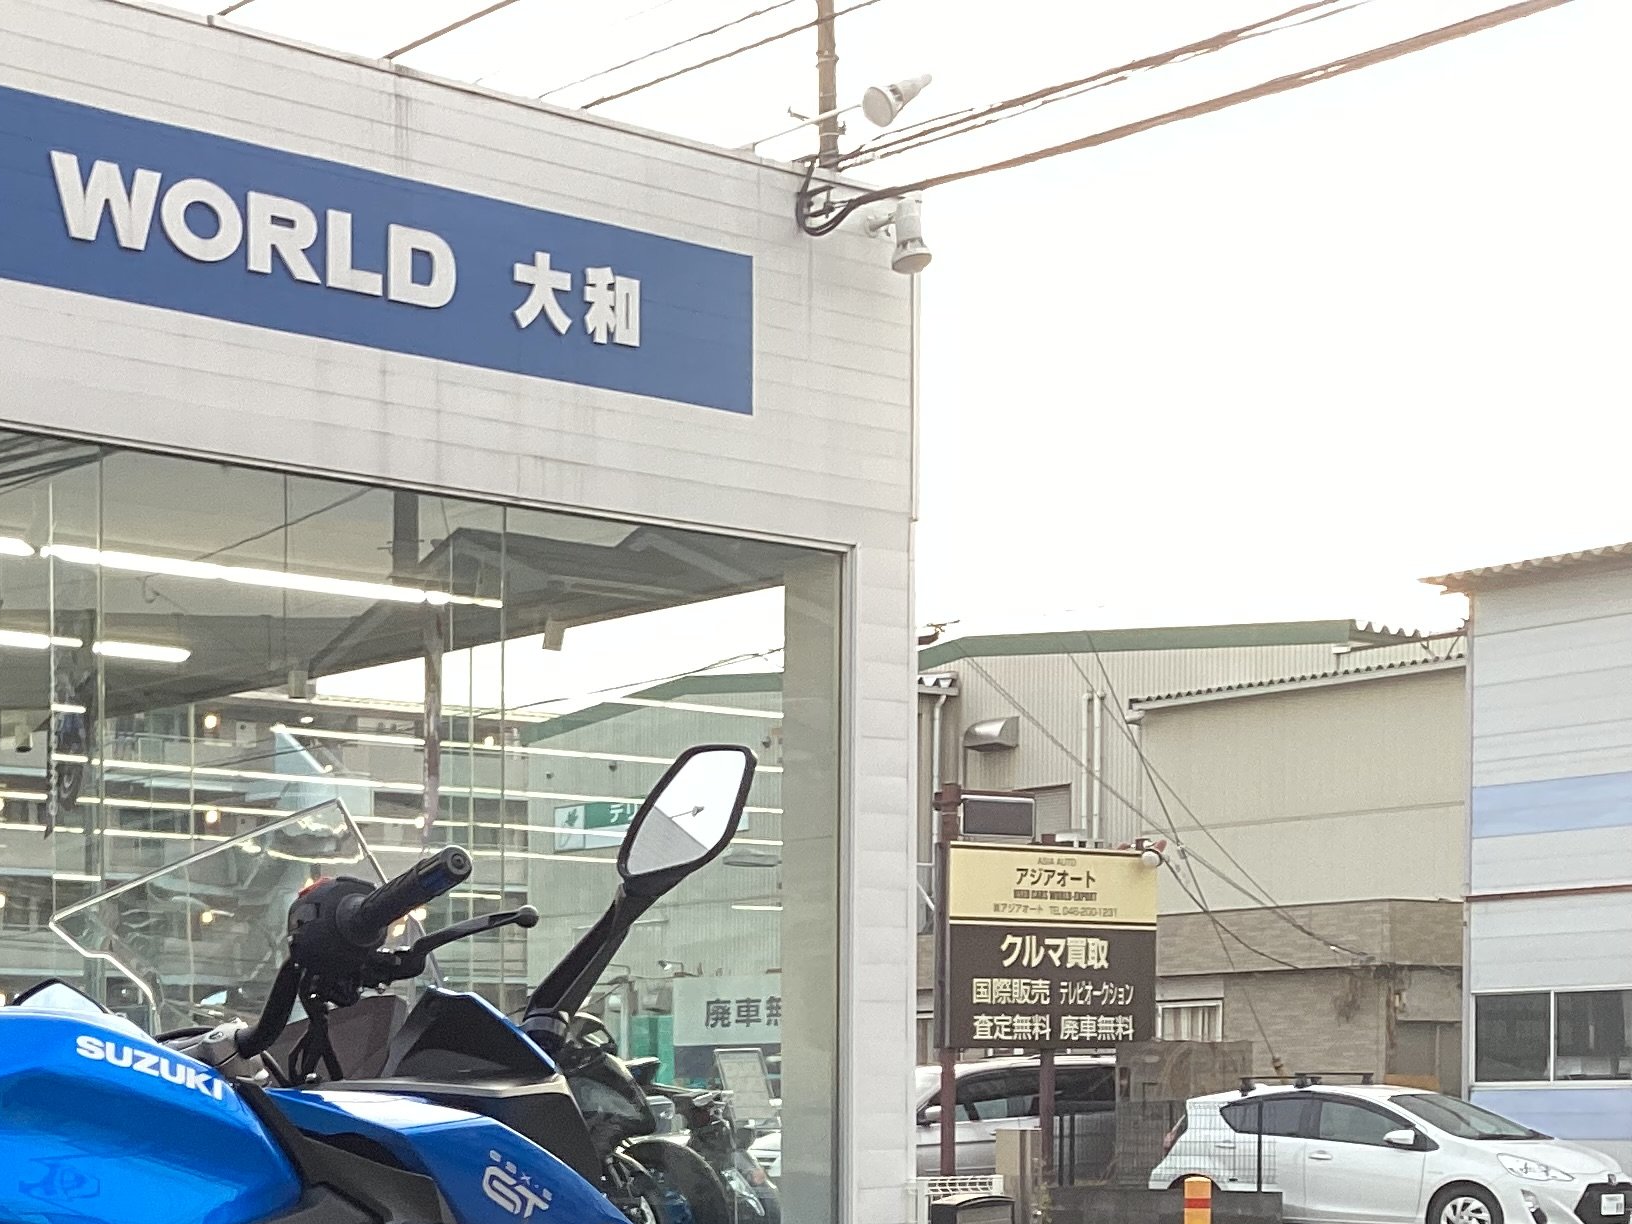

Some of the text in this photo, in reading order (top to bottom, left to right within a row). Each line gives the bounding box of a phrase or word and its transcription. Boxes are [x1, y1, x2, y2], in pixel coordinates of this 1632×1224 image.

[50, 150, 458, 309] WORLD
[512, 251, 641, 348] 大和
[1015, 867, 1096, 889] アジアオート
[1000, 934, 1110, 969] クルマ買取
[972, 978, 1134, 1006] 国際販売 テレビオークション
[972, 1013, 1135, 1041] 査定無料 廃車無料
[75, 1035, 223, 1101] SUZUKI
